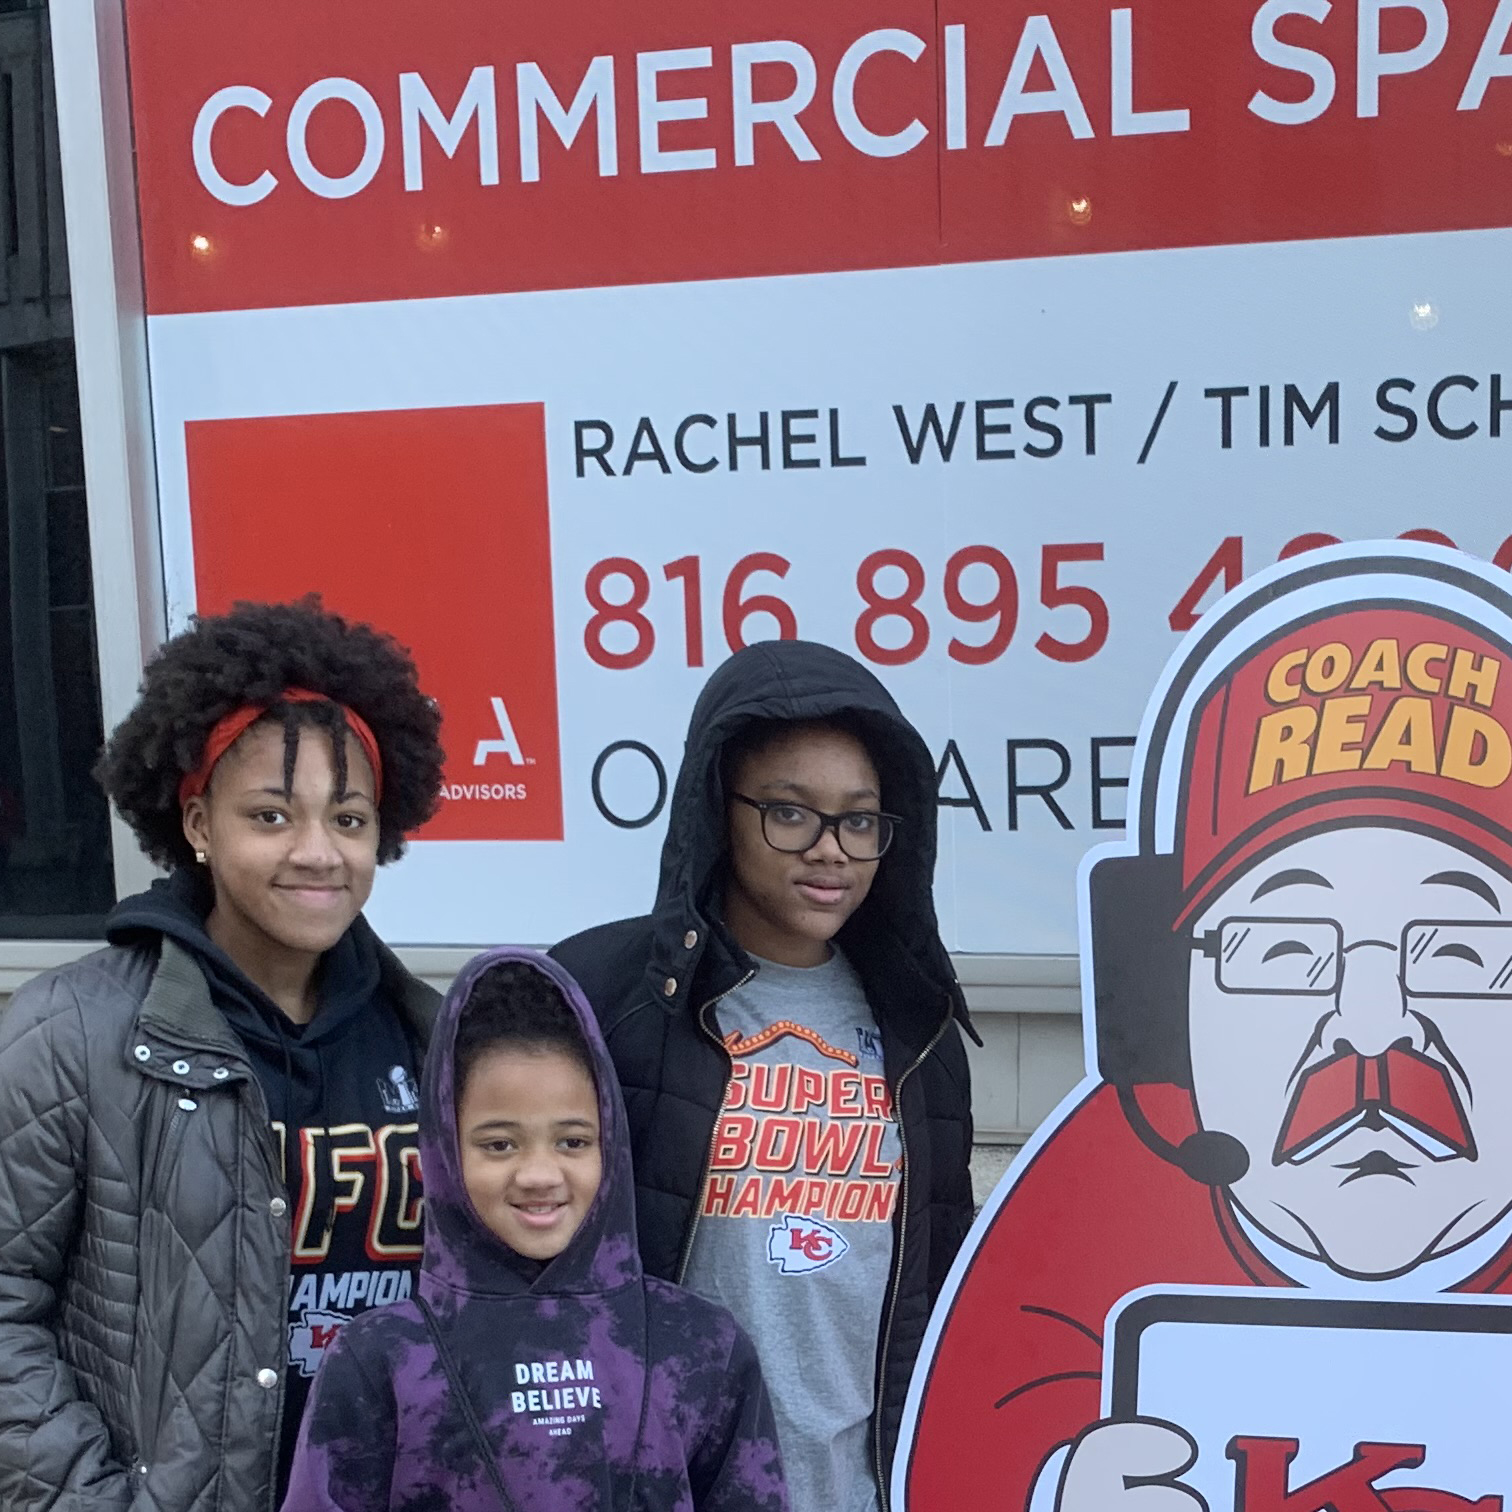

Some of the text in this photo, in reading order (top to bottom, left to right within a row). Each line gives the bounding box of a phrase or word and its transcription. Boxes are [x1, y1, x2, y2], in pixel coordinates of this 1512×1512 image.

[192, 8, 1190, 207] COMMERCIAL
[574, 408, 866, 478] RACHEL
[893, 394, 1112, 466] WEST
[1204, 381, 1340, 449] TIM
[584, 552, 797, 669] 816
[854, 543, 1110, 665] 895
[1265, 638, 1500, 707] COACH
[439, 784, 527, 800] ADVISORS
[726, 1062, 894, 1121] SUPER
[711, 1114, 892, 1177] BOWL
[702, 1176, 900, 1222] HAMPION
[511, 1387, 602, 1413] BELIEVE
[515, 1359, 594, 1385] DREAM
